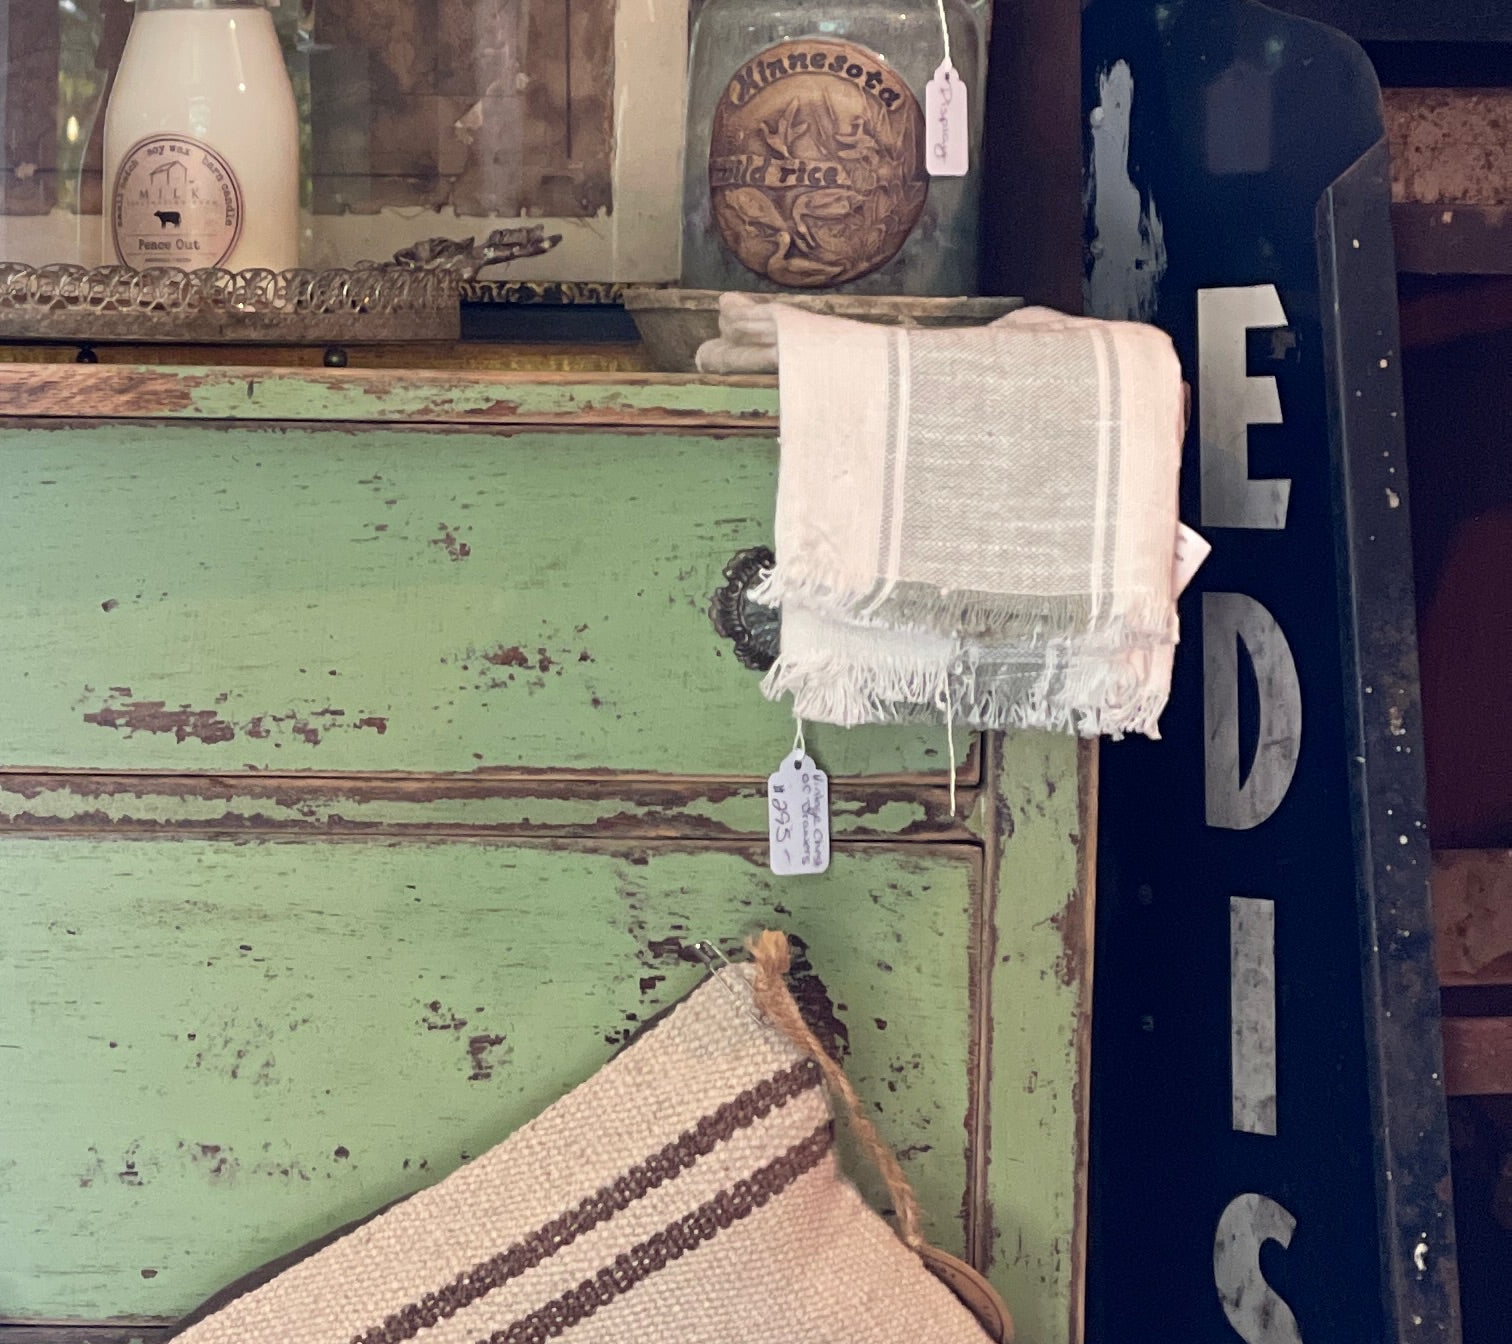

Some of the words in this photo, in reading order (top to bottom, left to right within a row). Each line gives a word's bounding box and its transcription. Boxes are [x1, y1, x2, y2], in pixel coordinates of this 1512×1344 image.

[730, 52, 901, 109] Minnesota
[778, 160, 840, 186] rice
[138, 238, 172, 251] Peace
[175, 238, 201, 251] Out
